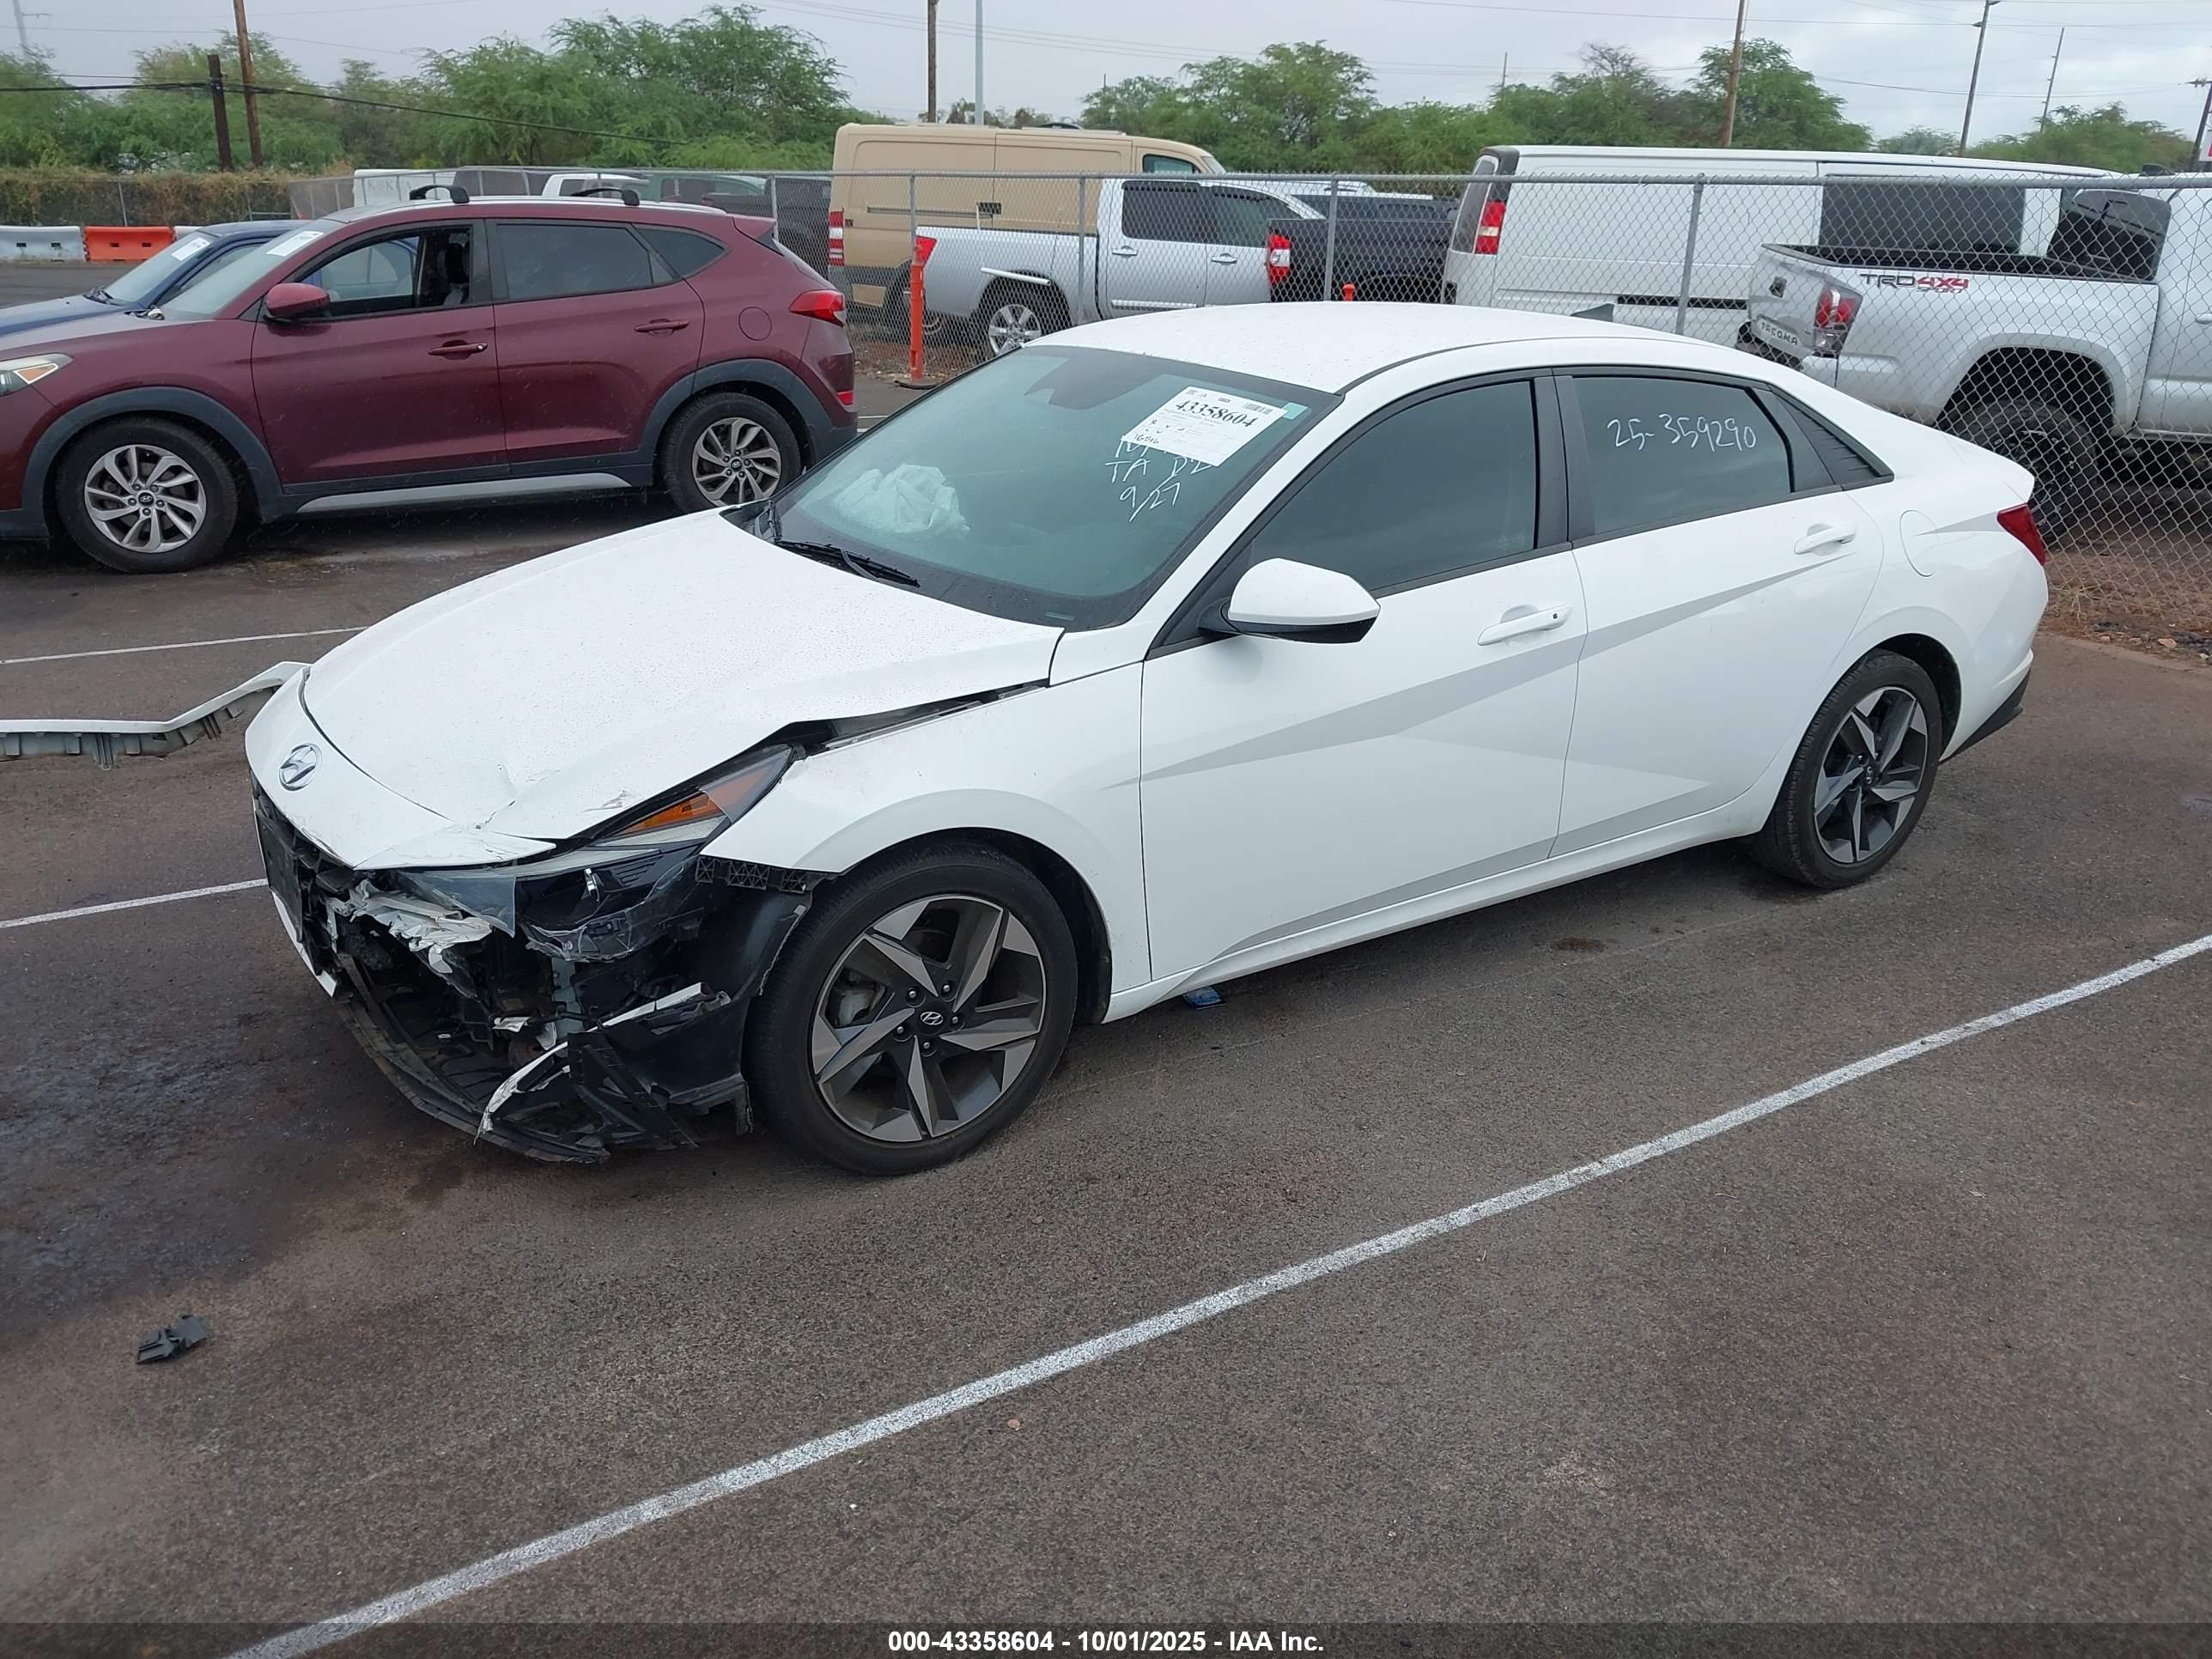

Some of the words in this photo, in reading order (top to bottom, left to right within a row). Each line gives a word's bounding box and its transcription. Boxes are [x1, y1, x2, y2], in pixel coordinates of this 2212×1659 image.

[1860, 273, 1916, 289] TRD
[1760, 321, 1798, 345] TACOMA
[1176, 398, 1260, 428] 43358604
[1120, 476, 1181, 522] 9/27
